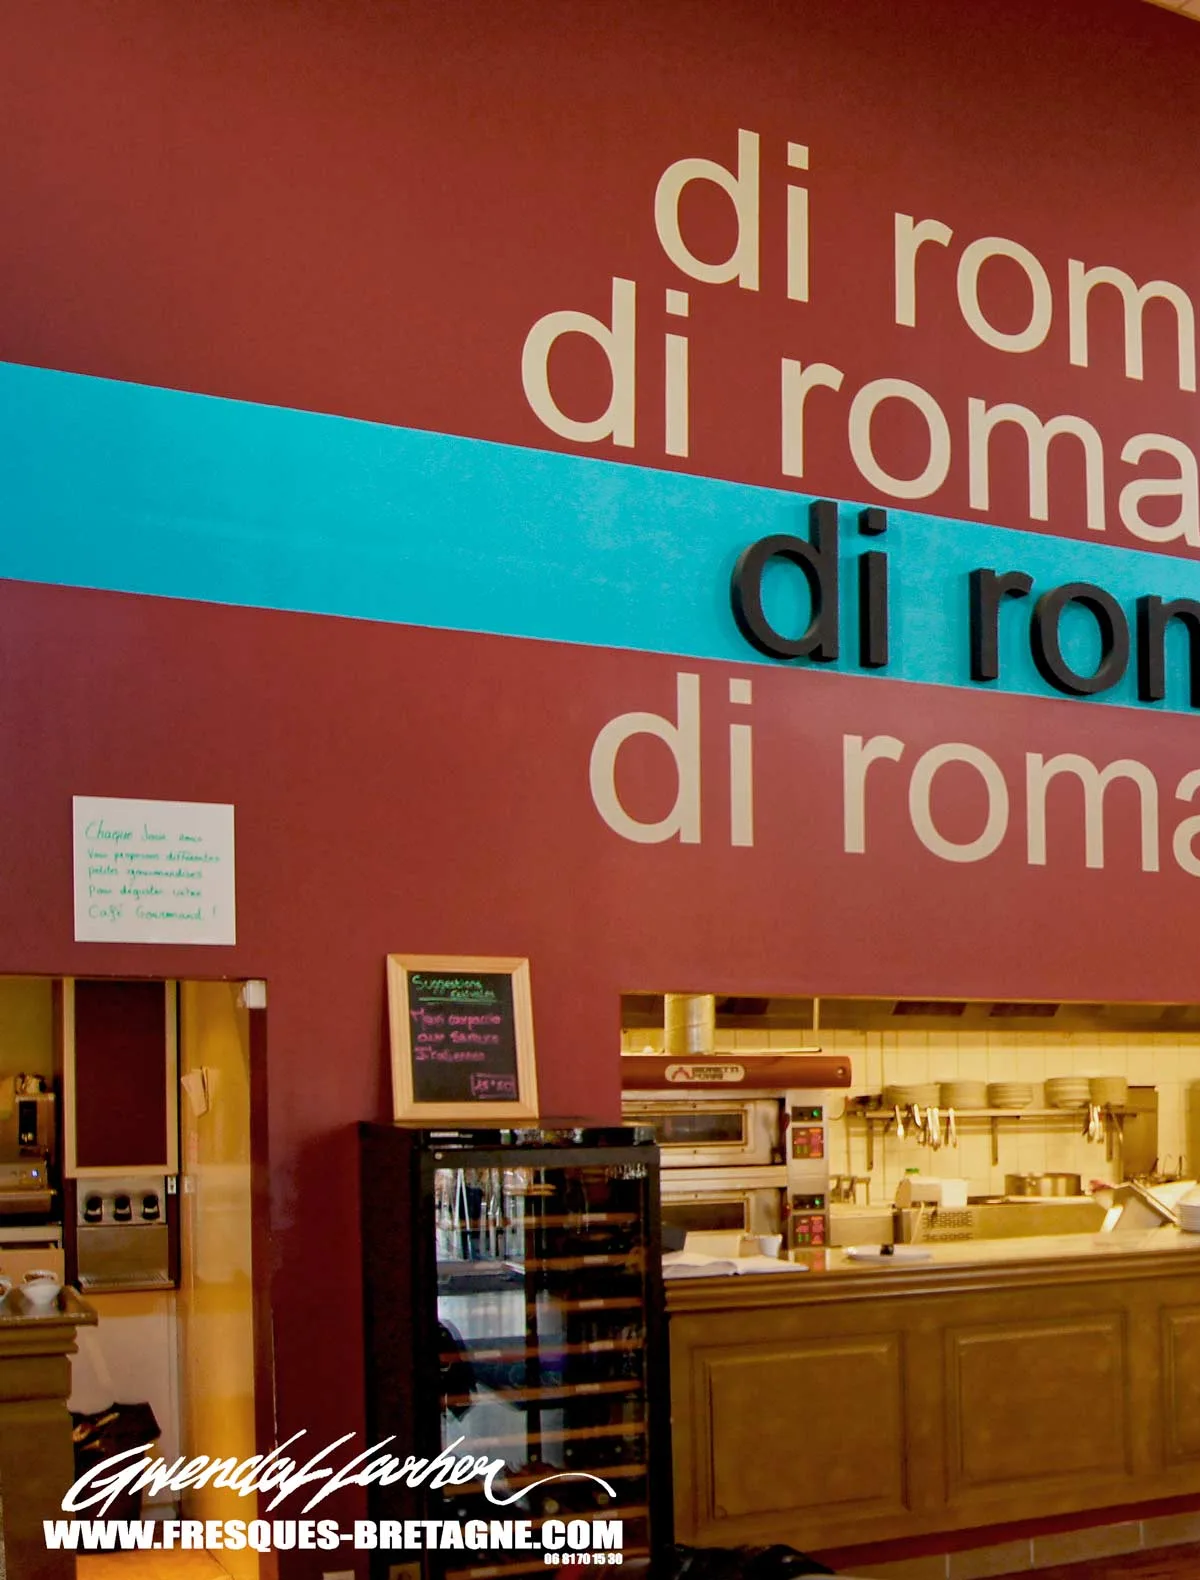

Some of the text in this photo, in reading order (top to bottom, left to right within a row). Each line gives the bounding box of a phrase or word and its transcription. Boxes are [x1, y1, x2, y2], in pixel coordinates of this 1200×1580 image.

[653, 128, 809, 303] di
[521, 276, 689, 458] di
[729, 499, 889, 671] di
[85, 820, 132, 844] Chaque
[588, 671, 754, 848] di
